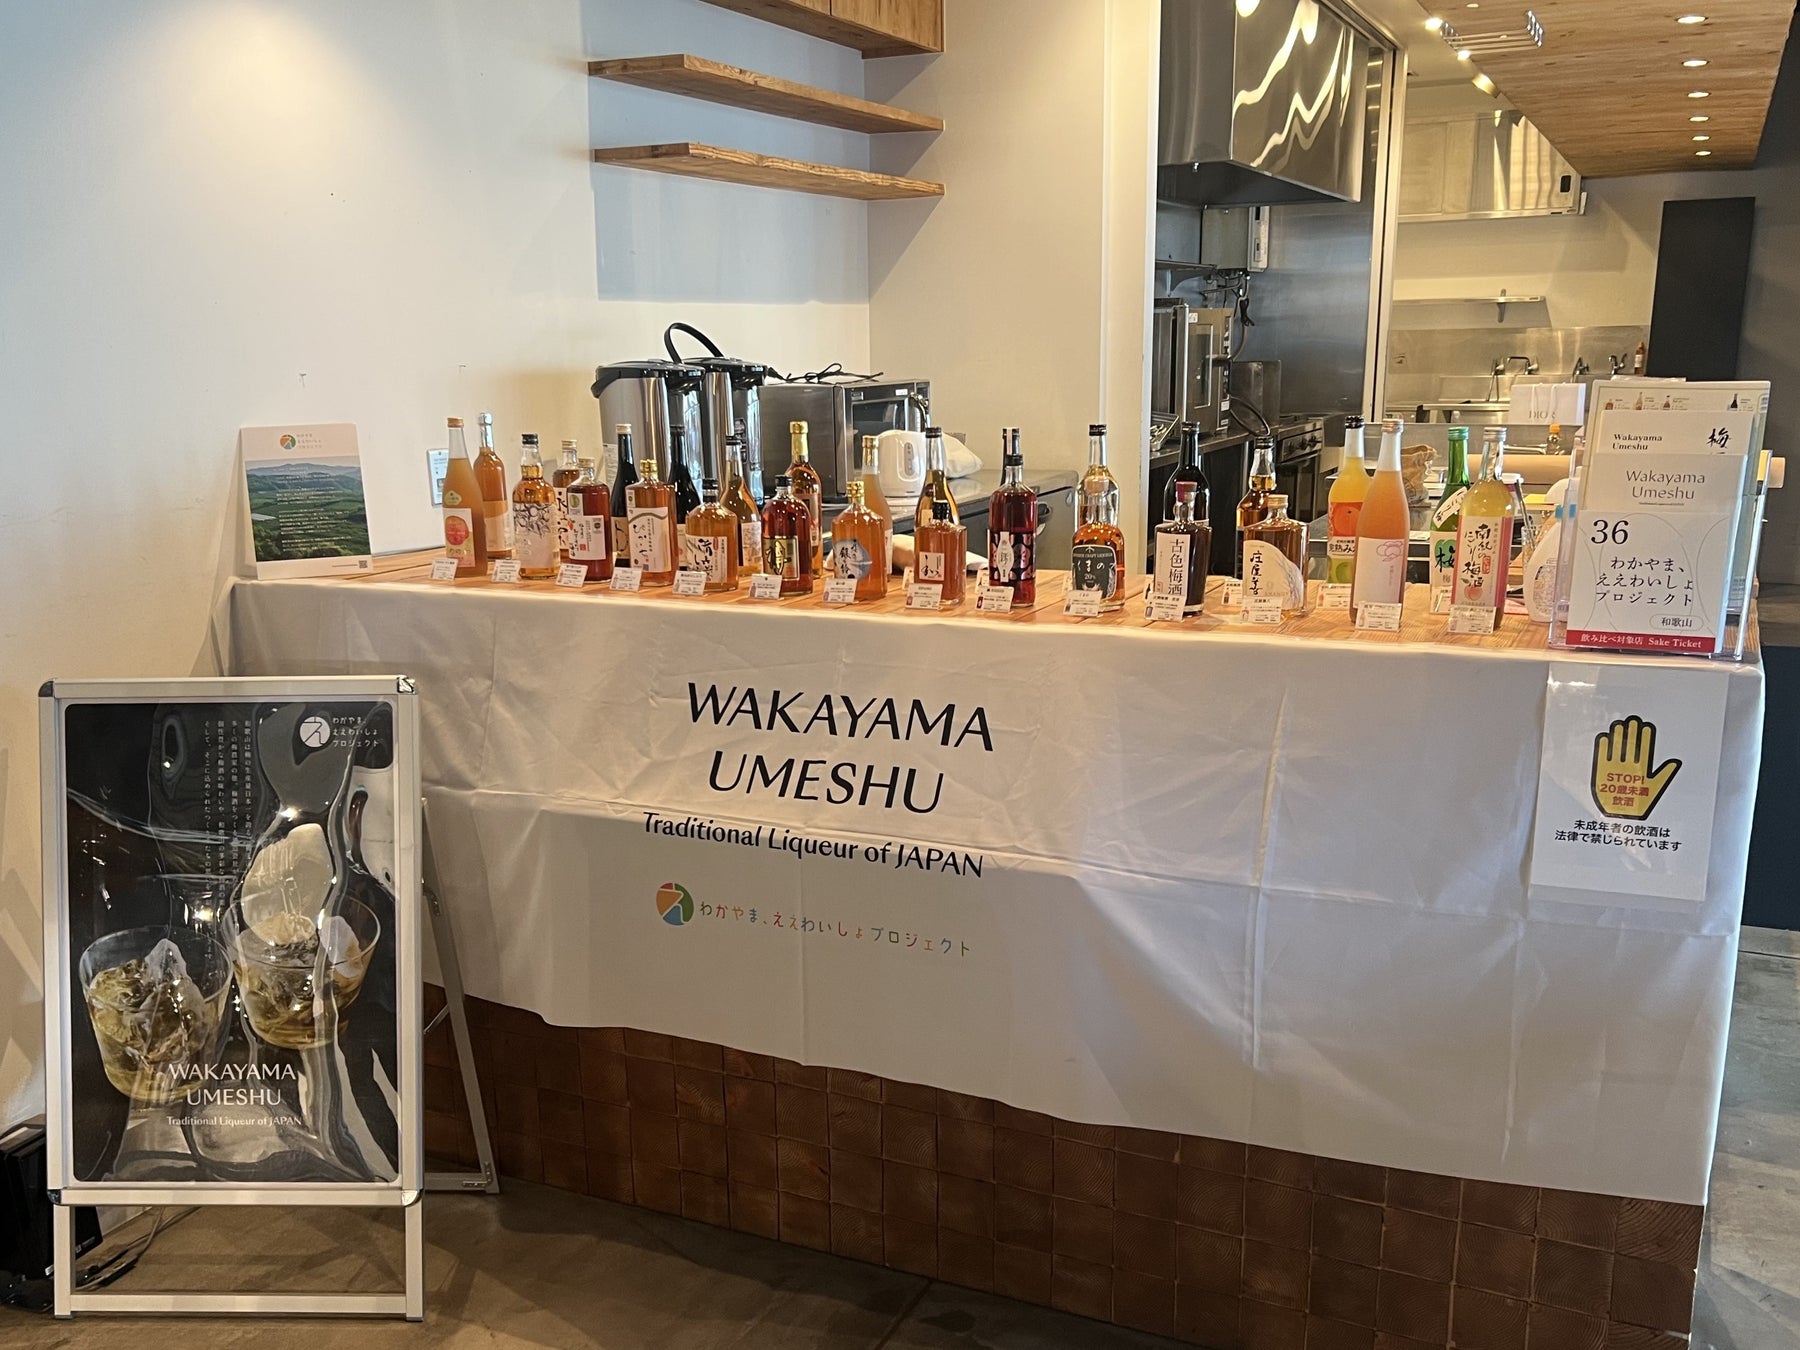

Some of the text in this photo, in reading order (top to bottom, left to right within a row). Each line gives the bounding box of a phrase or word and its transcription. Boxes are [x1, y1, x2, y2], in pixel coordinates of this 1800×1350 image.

[1612, 442, 1648, 451] Umeshu
[1614, 433, 1663, 443] Wakayama
[1706, 427, 1732, 454] 梅
[1626, 470, 1706, 486] Wakayama
[1632, 486, 1696, 500] Umeshu
[1590, 520, 1629, 544] 36
[1168, 538, 1184, 596] 古色梅酒
[1610, 556, 1685, 573] わかやま、
[1596, 573, 1694, 590] ええわいしょ
[1596, 591, 1693, 606] プロジェクト
[1661, 617, 1693, 628] 和歌山
[1580, 633, 1702, 649] 飲み比べ対象店 Sake Ticket
[687, 682, 994, 752] WAKAYAMA
[708, 750, 944, 814] UMESHU
[1606, 772, 1645, 786] STOP!
[1600, 784, 1650, 797] 20歳未満
[1612, 796, 1634, 808] 飲酒
[1573, 820, 1671, 838] 未成年者の飲酒は
[643, 812, 984, 878] Traditional Liqueur of JAPAN
[1554, 830, 1682, 852] 法律で禁じられています
[699, 900, 971, 957] わかやま、ええわいしょプロジェクト
[168, 1063, 296, 1080] WAKAYAMA
[186, 1088, 282, 1106] UMESHU
[166, 1116, 302, 1128] Traditional Liqueur of JAPAN
